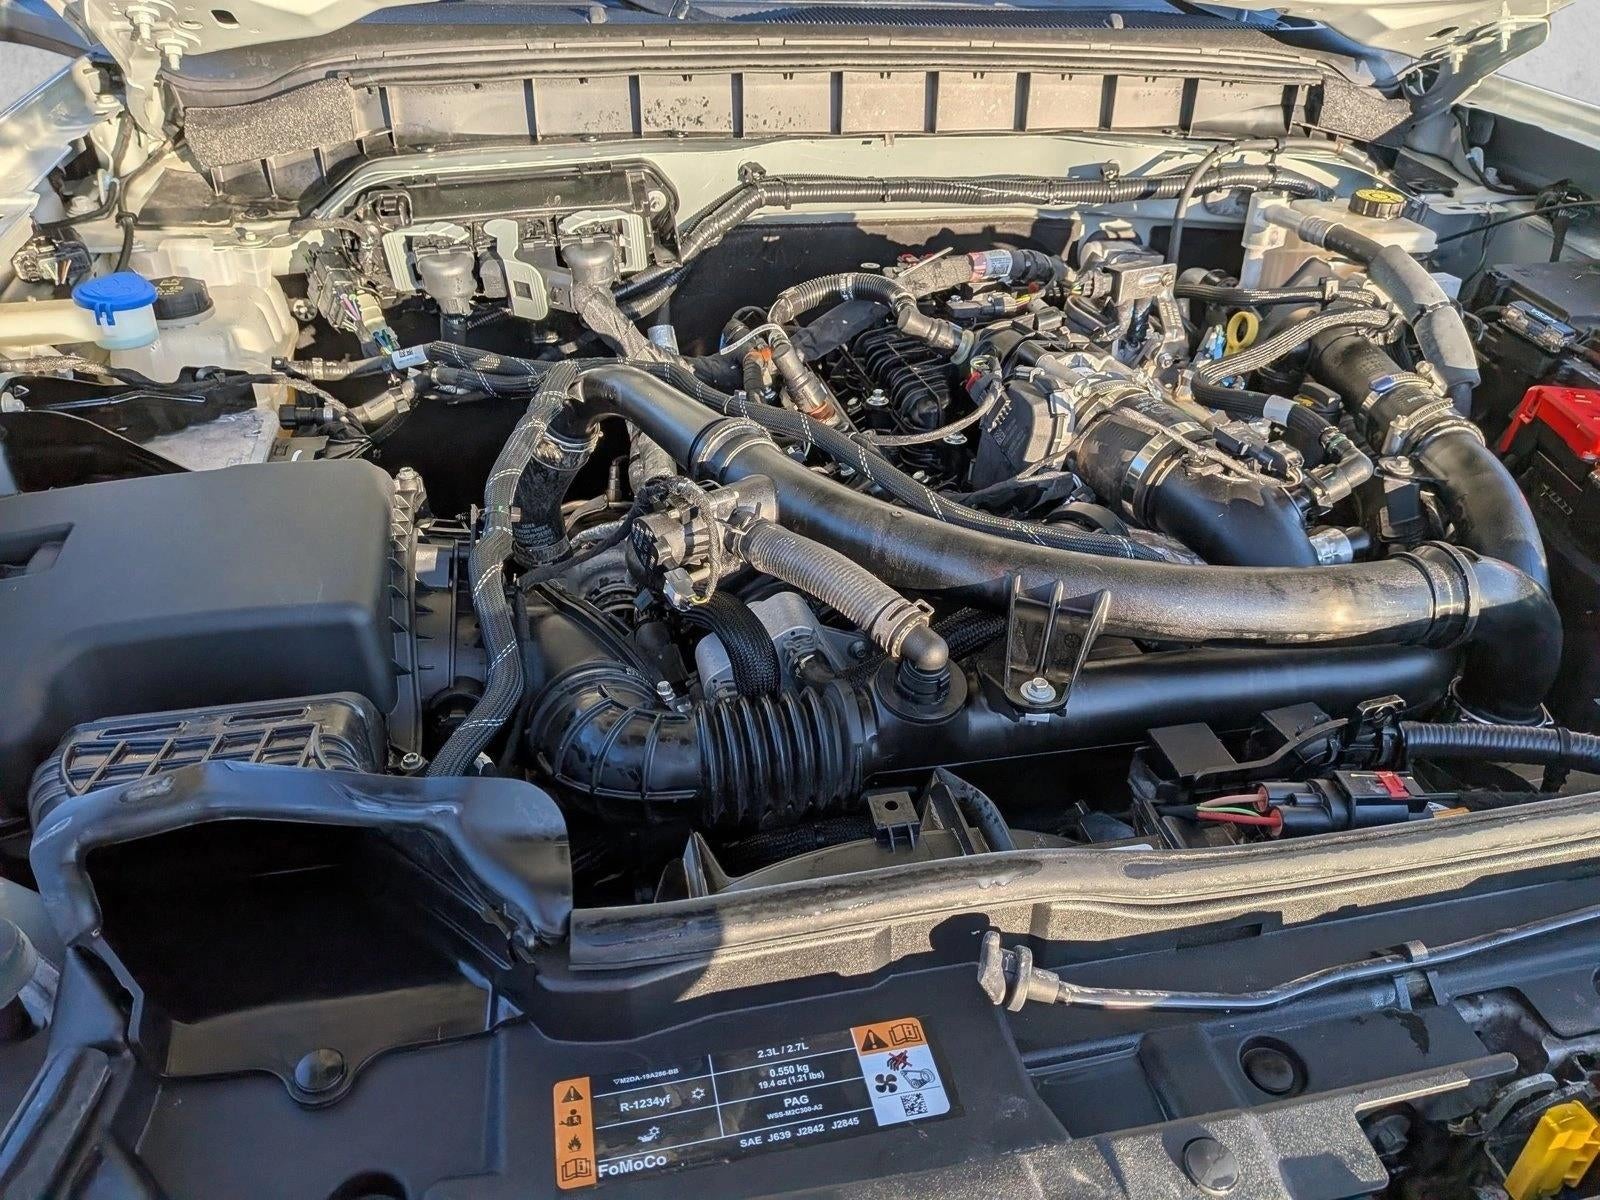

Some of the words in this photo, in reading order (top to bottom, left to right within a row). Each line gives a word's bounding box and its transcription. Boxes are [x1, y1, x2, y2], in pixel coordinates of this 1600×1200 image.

[757, 1048, 780, 1058] 2.3L
[787, 1042, 809, 1053] 2.7L
[758, 1080, 776, 1089] 19.4
[777, 1078, 787, 1086] oz
[788, 1073, 807, 1085] (1.21
[808, 1070, 825, 1080] lbs)
[769, 1065, 795, 1077] 0.550
[796, 1064, 809, 1073] kg
[620, 1094, 671, 1112] R-1234yf
[783, 1095, 809, 1107] PAG
[740, 1135, 763, 1147] SAE
[767, 1131, 791, 1142] J639
[796, 1124, 825, 1137] J2842
[831, 1117, 860, 1130] J2845
[598, 1155, 667, 1177] FoMoCo
